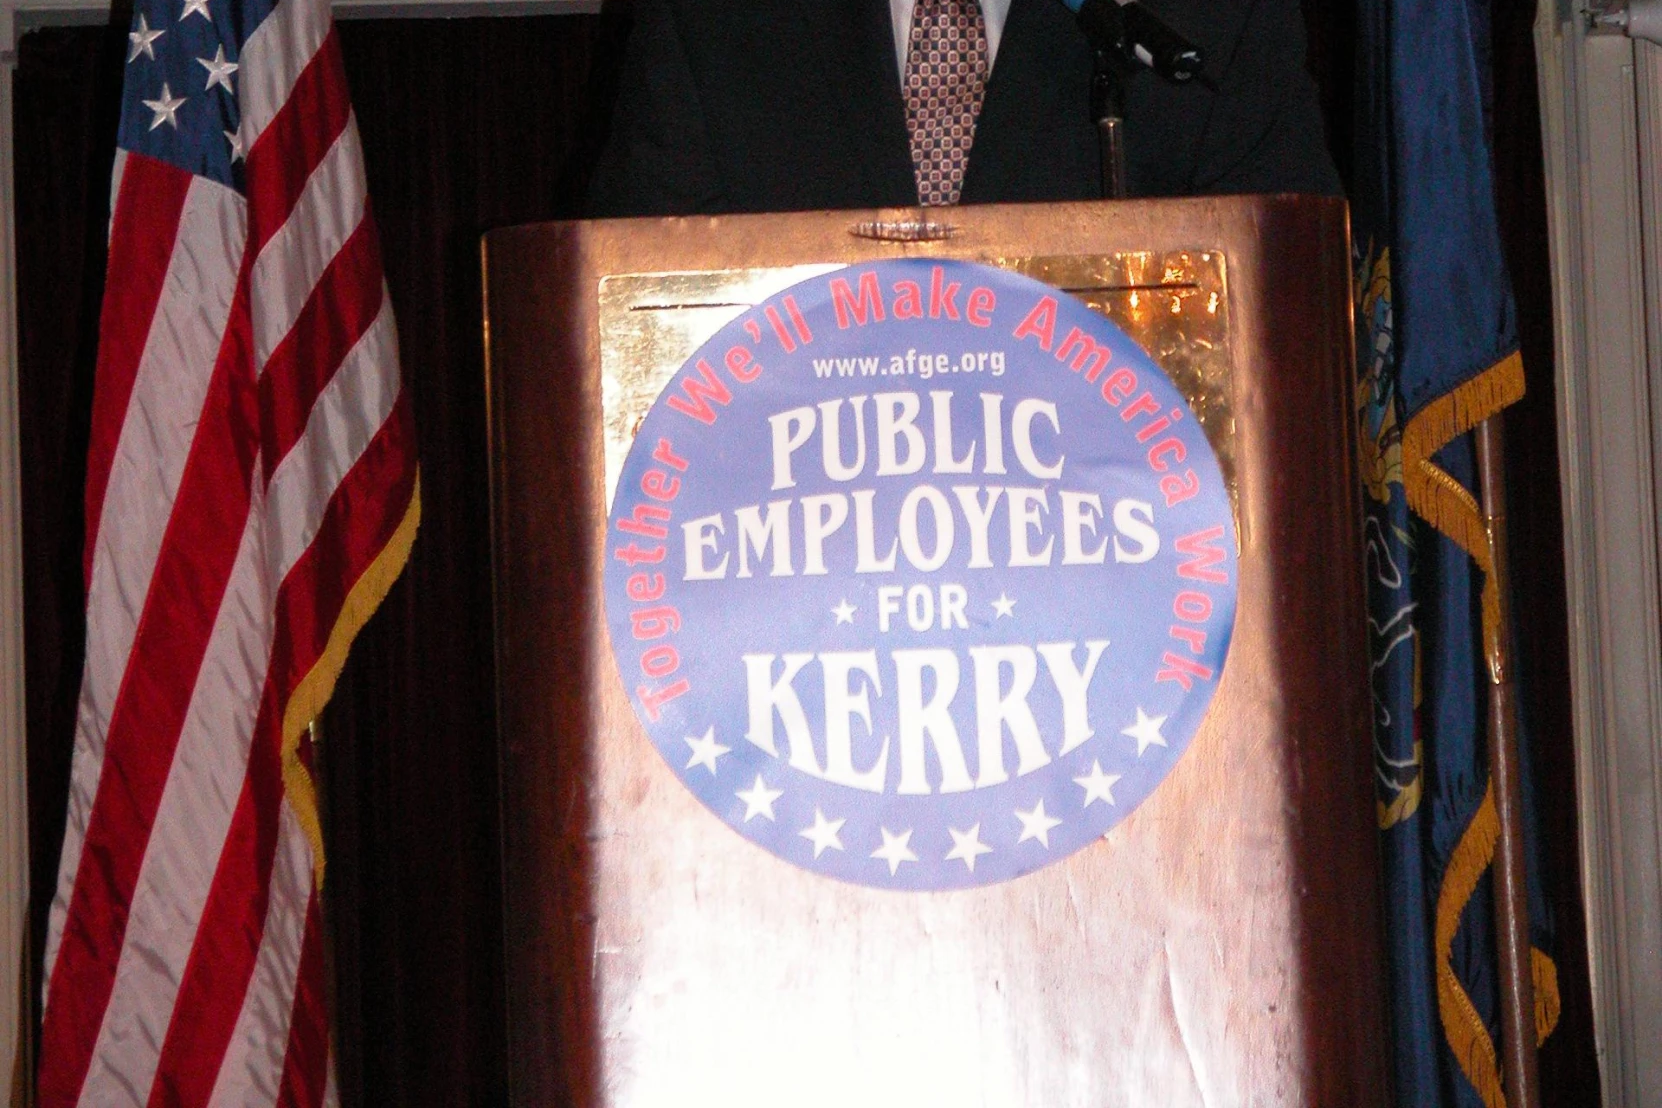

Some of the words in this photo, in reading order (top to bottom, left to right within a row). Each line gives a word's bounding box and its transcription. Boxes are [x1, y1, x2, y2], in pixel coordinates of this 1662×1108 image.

[813, 349, 1006, 379] www.afge.org
[768, 392, 1065, 489] PUBLIC
[615, 440, 691, 722] Together
[667, 298, 811, 427] We'll
[830, 267, 998, 330] Make
[1013, 298, 1200, 508] America
[1157, 527, 1228, 692] Work
[682, 486, 1160, 581] EMPLOYEES
[878, 584, 969, 632] FOR
[743, 640, 1110, 795] KERRY
